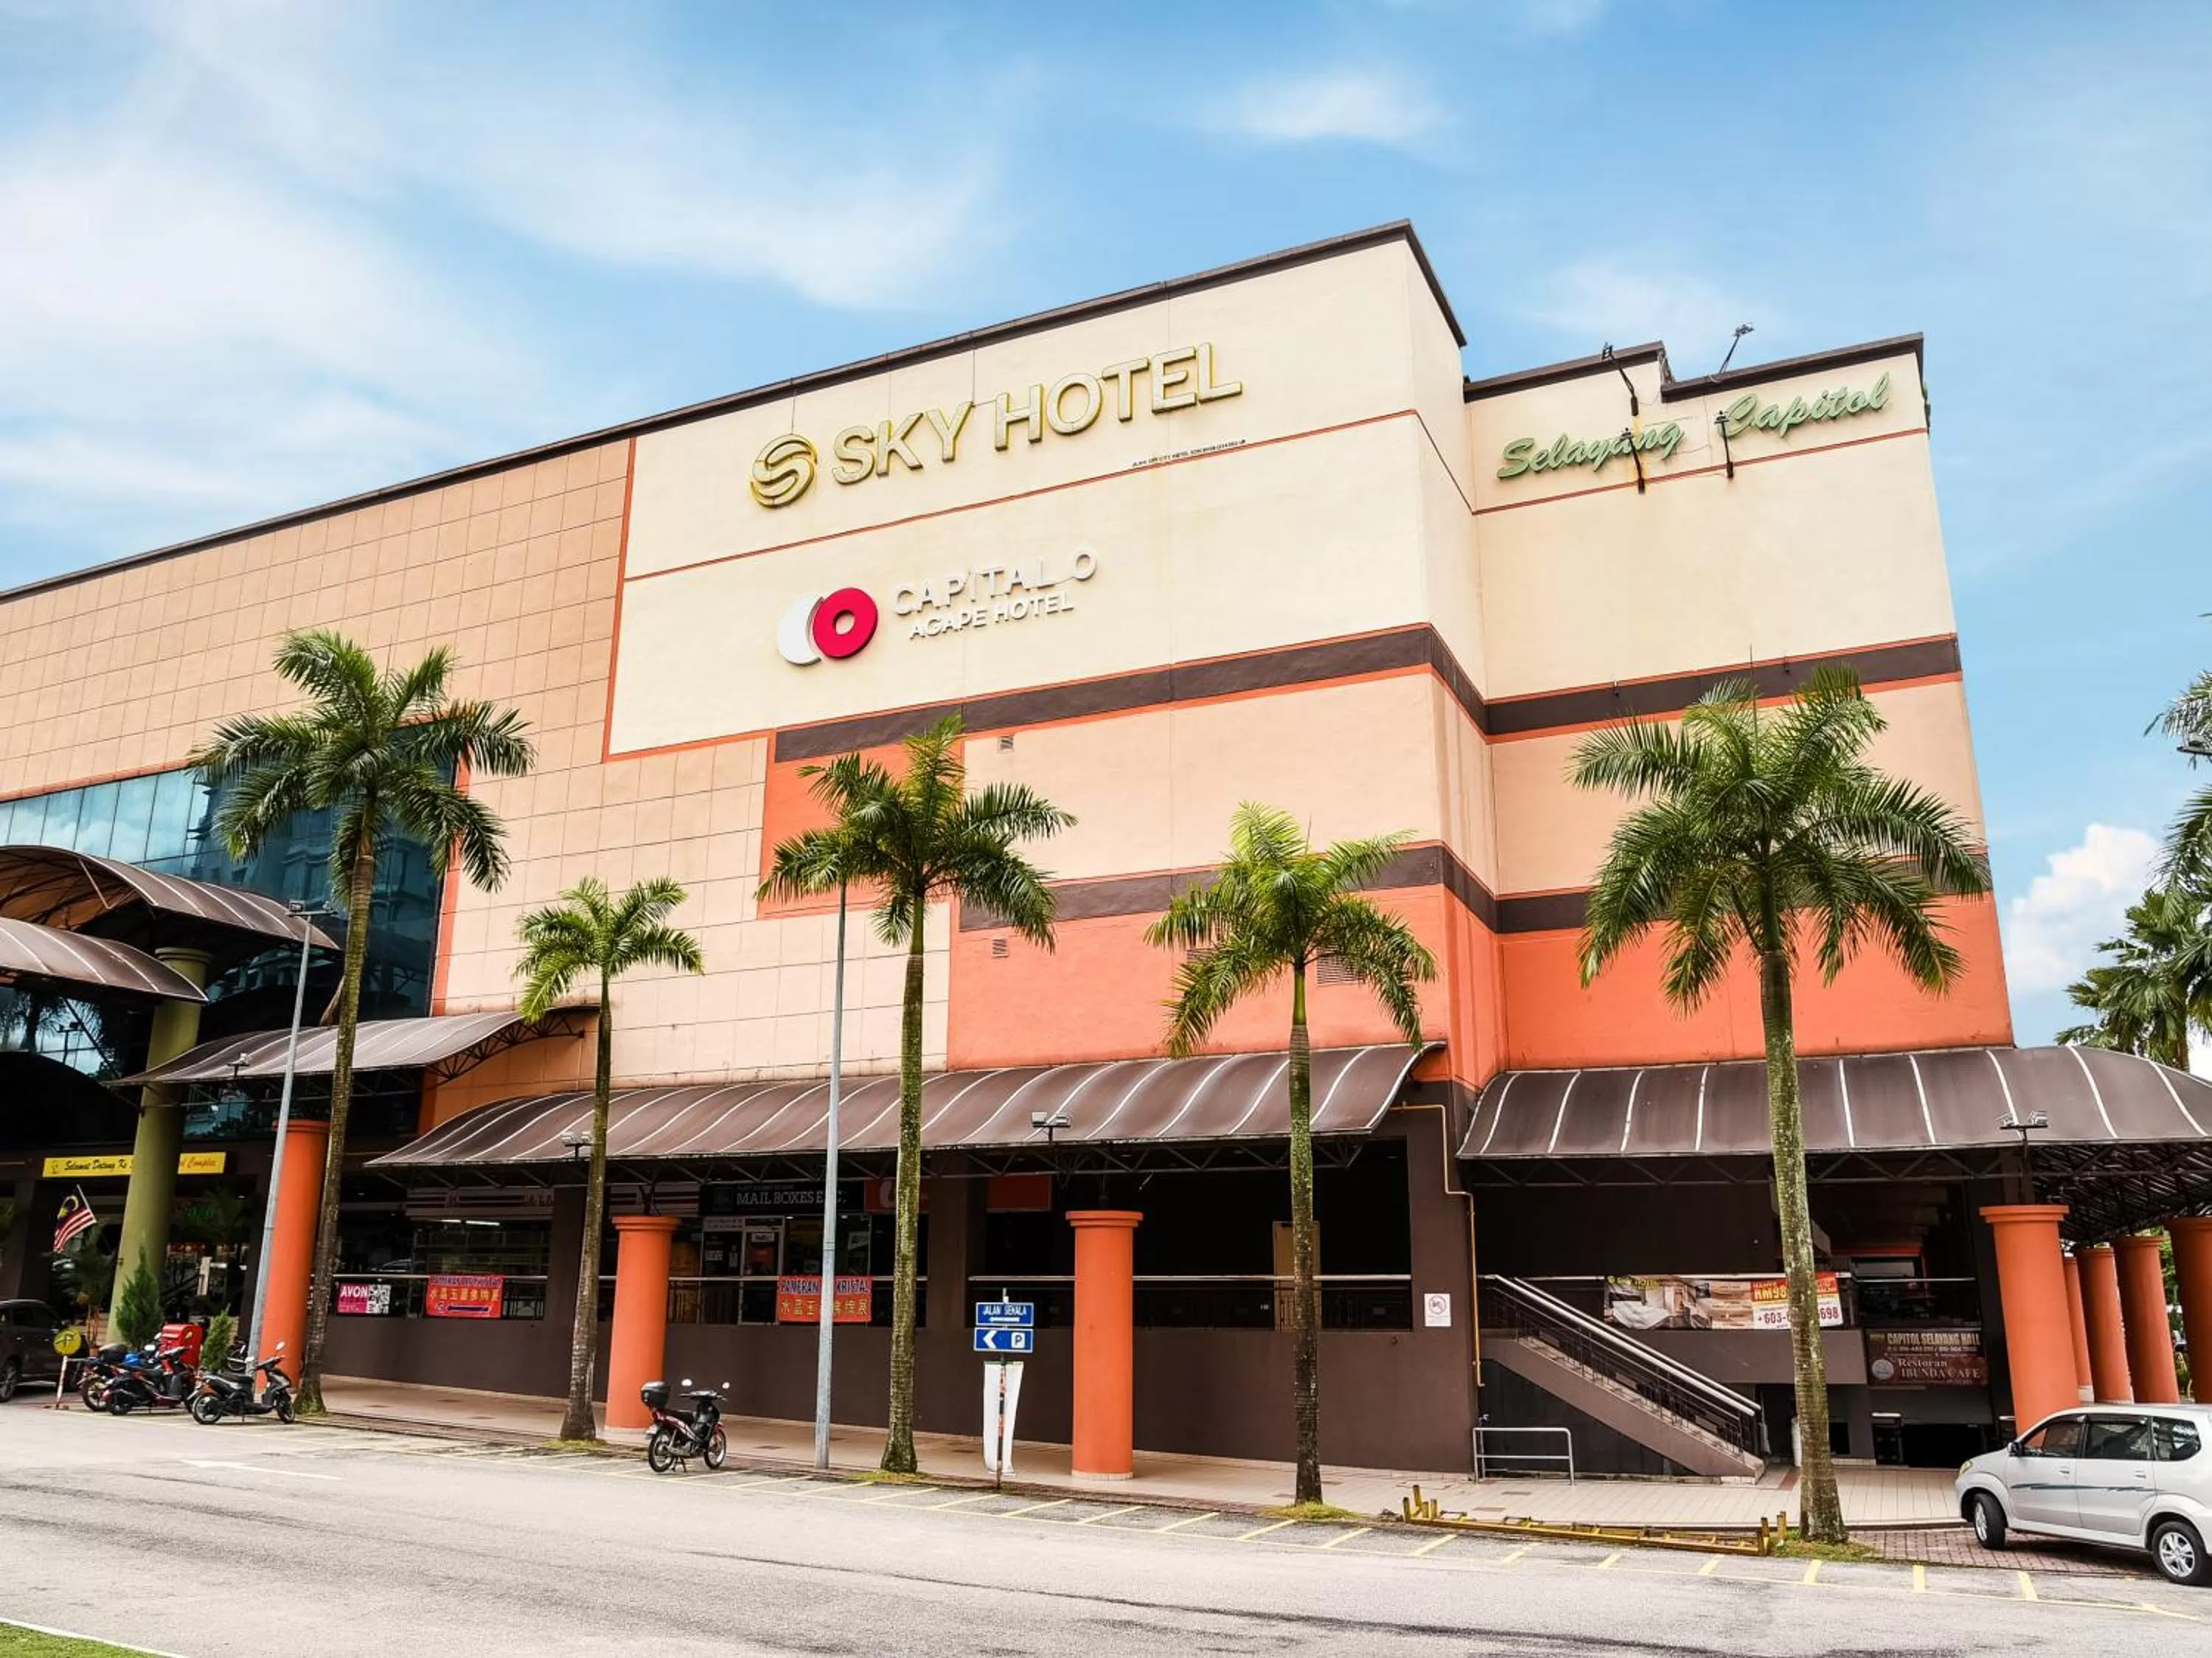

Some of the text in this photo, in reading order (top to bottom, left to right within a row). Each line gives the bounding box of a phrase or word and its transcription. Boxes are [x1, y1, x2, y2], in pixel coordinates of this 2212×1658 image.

[832, 400, 975, 485] SKY
[995, 341, 1242, 451] HOTEL
[1497, 372, 1891, 479] Selayang Capitol
[893, 547, 1098, 615] CAPITAL O
[910, 591, 1074, 640] AGAPE HOTEL
[737, 1191, 771, 1204] MAIL
[773, 1190, 815, 1204] BOXES
[340, 1286, 368, 1298] AVON
[982, 1304, 1001, 1315] JALAN
[1015, 1334, 1023, 1346] P
[1887, 1333, 1919, 1345] CAPITOL
[1921, 1333, 1961, 1345] SELAYANG
[1961, 1333, 1980, 1345] HALL
[1898, 1358, 1947, 1367] Restoran
[1902, 1368, 1980, 1378] IBUNDA CAFE
